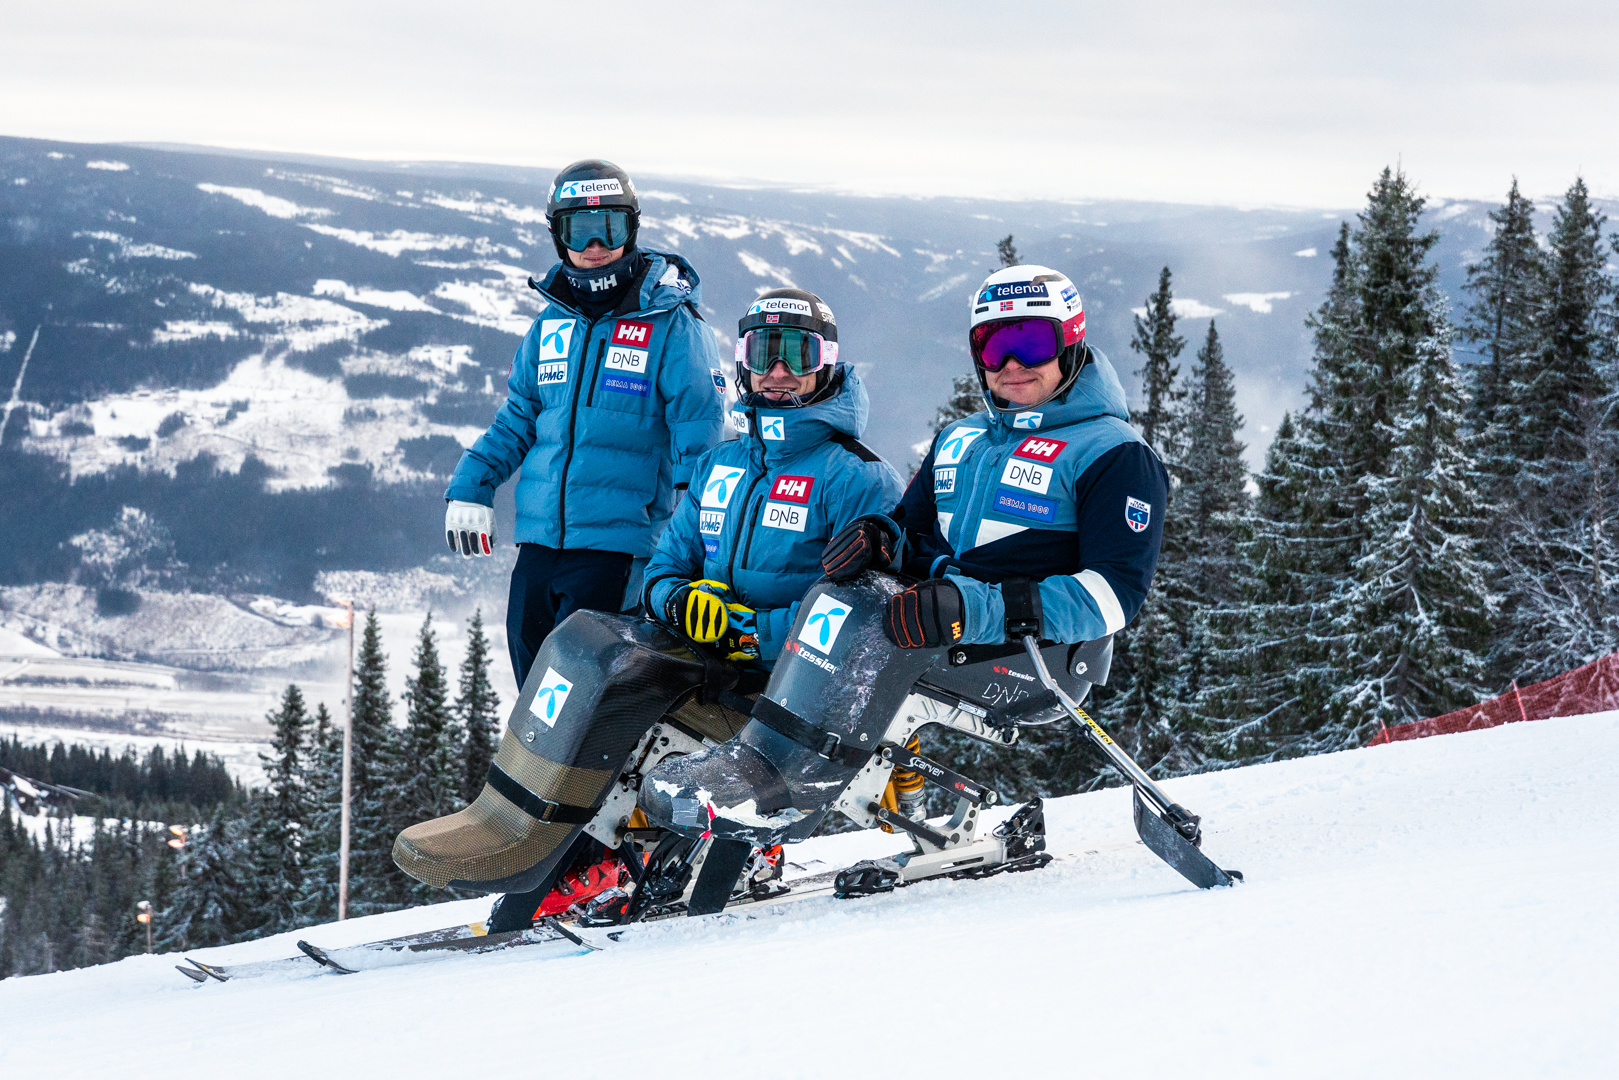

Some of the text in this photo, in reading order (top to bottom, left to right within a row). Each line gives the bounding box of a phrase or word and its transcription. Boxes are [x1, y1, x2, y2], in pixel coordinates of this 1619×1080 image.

[581, 182, 620, 193] telenor
[589, 273, 618, 292] HH
[997, 284, 1044, 296] telenor
[766, 300, 809, 312] telenor
[617, 324, 647, 342] HH
[612, 350, 640, 369] DNB
[539, 370, 565, 382] KPMG
[732, 413, 746, 430] DNB
[1021, 439, 1059, 457] HH
[934, 478, 953, 490] PMG
[1009, 465, 1043, 486] DNB
[776, 479, 808, 497] HH
[999, 496, 1050, 515] REMA 1000
[769, 506, 799, 527] DNB
[951, 621, 961, 640] HH
[1007, 669, 1036, 682] tessier
